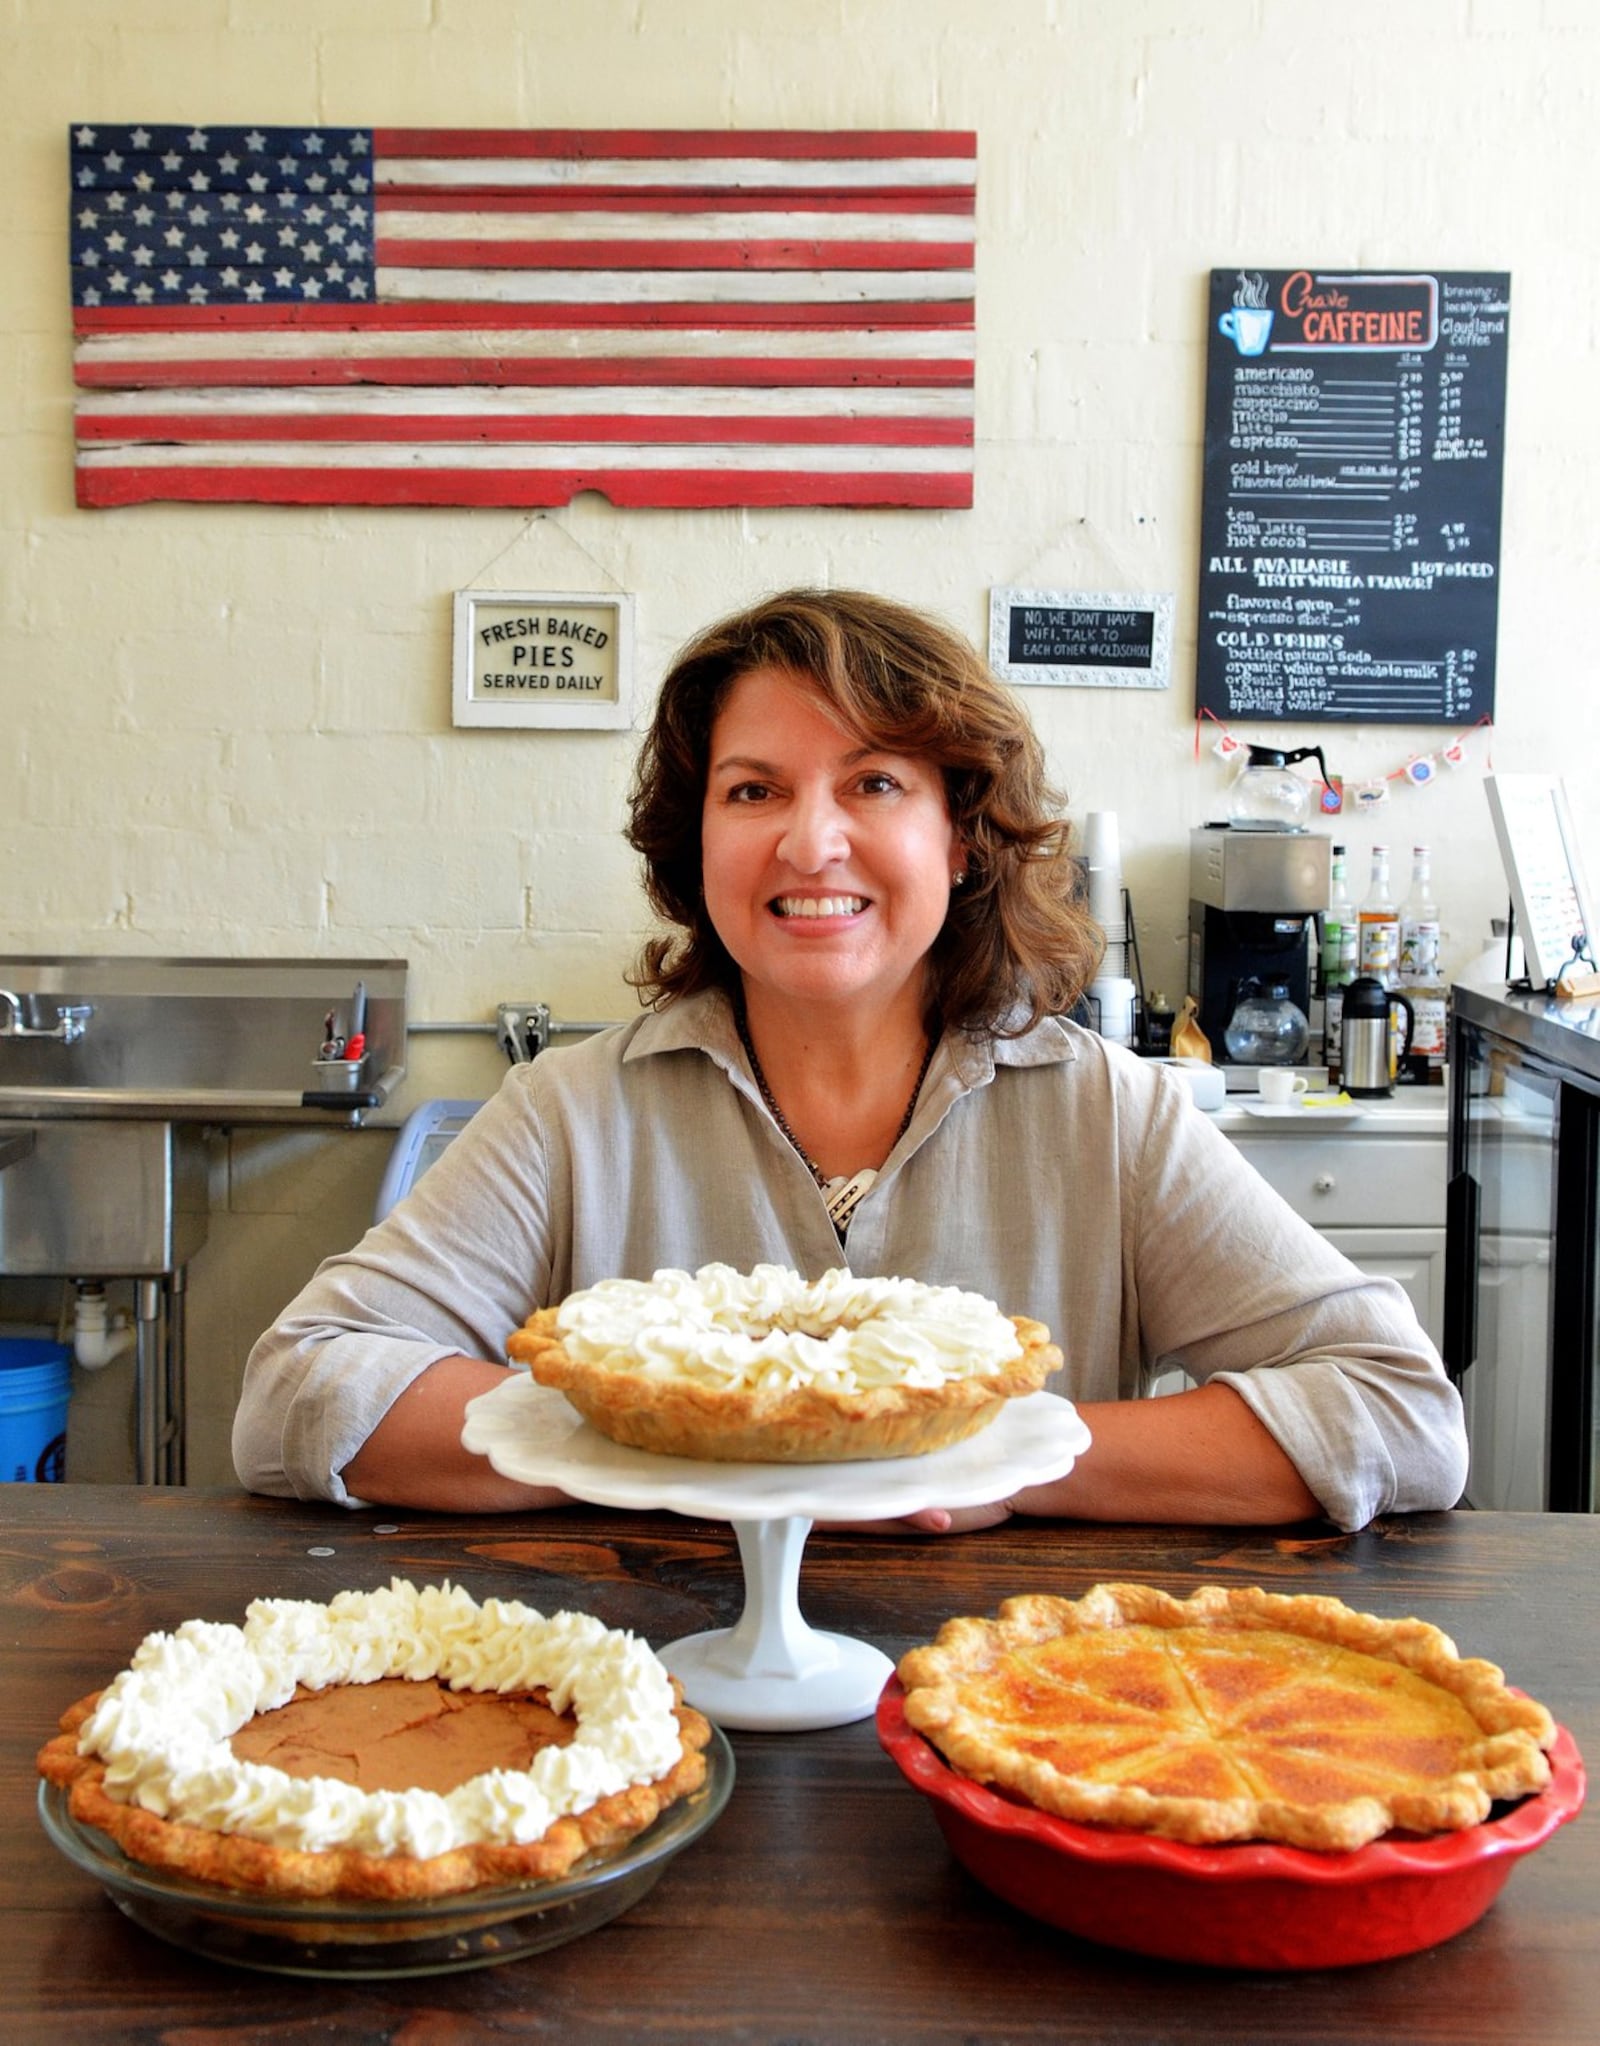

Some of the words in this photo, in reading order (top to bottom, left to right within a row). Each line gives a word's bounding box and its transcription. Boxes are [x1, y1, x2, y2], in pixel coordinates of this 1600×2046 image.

[1281, 271, 1349, 317] Crave
[1303, 311, 1422, 342] CAFFEINE
[1440, 317, 1504, 336] Cloudland
[1234, 367, 1314, 381] americano
[1235, 382, 1320, 397] macchiato
[1232, 398, 1319, 412] cappuccino
[1232, 410, 1288, 423] mocha
[1232, 422, 1274, 435] latte
[1229, 435, 1299, 452] espresso
[1230, 460, 1260, 475] cold
[1264, 460, 1299, 475] brew
[1232, 475, 1283, 488] flavored
[1284, 475, 1309, 488] cold
[1225, 507, 1255, 521] tea
[1227, 522, 1261, 535] chai
[1265, 522, 1306, 536] latte
[1226, 535, 1256, 548] hot
[1260, 536, 1307, 548] cocoa
[1209, 556, 1247, 573] ALL
[1252, 557, 1352, 575] AVAILABLE
[1254, 573, 1287, 588] TRY
[1288, 574, 1307, 588] IT
[1308, 574, 1352, 589] WITH
[1352, 575, 1365, 588] A
[1367, 575, 1433, 590] FLAVOR!
[1226, 593, 1293, 611] flavored
[1294, 598, 1334, 615] syrup
[1048, 611, 1067, 625] WE
[1107, 612, 1137, 627] HAVE
[1227, 611, 1295, 628] espresso
[1297, 612, 1330, 626] shot
[480, 617, 540, 647] FRESH
[547, 617, 609, 649] BAKED
[1024, 628, 1061, 642] WIFI.
[1061, 628, 1097, 642] TALK
[1101, 629, 1119, 642] TO
[1216, 631, 1270, 647] COLD
[1273, 632, 1344, 650] DRINKS
[513, 646, 574, 667] PIES
[1023, 644, 1050, 656] EACH
[1053, 644, 1087, 656] OTHER
[1089, 644, 1150, 659] #OLDSCHOOL
[1228, 647, 1283, 661] bottled
[1284, 649, 1334, 663] natural
[1225, 660, 1281, 677] organic
[1282, 661, 1324, 675] white
[1341, 663, 1401, 677] chocolate
[1402, 665, 1438, 678] milk
[483, 673, 549, 689] SERVED
[556, 675, 603, 690] DAILY
[1225, 674, 1283, 690] organic
[1288, 675, 1327, 689] juice
[1228, 686, 1284, 700] bottled
[1288, 687, 1336, 701] water
[1229, 699, 1283, 715] sparkling
[1286, 699, 1326, 711] water
